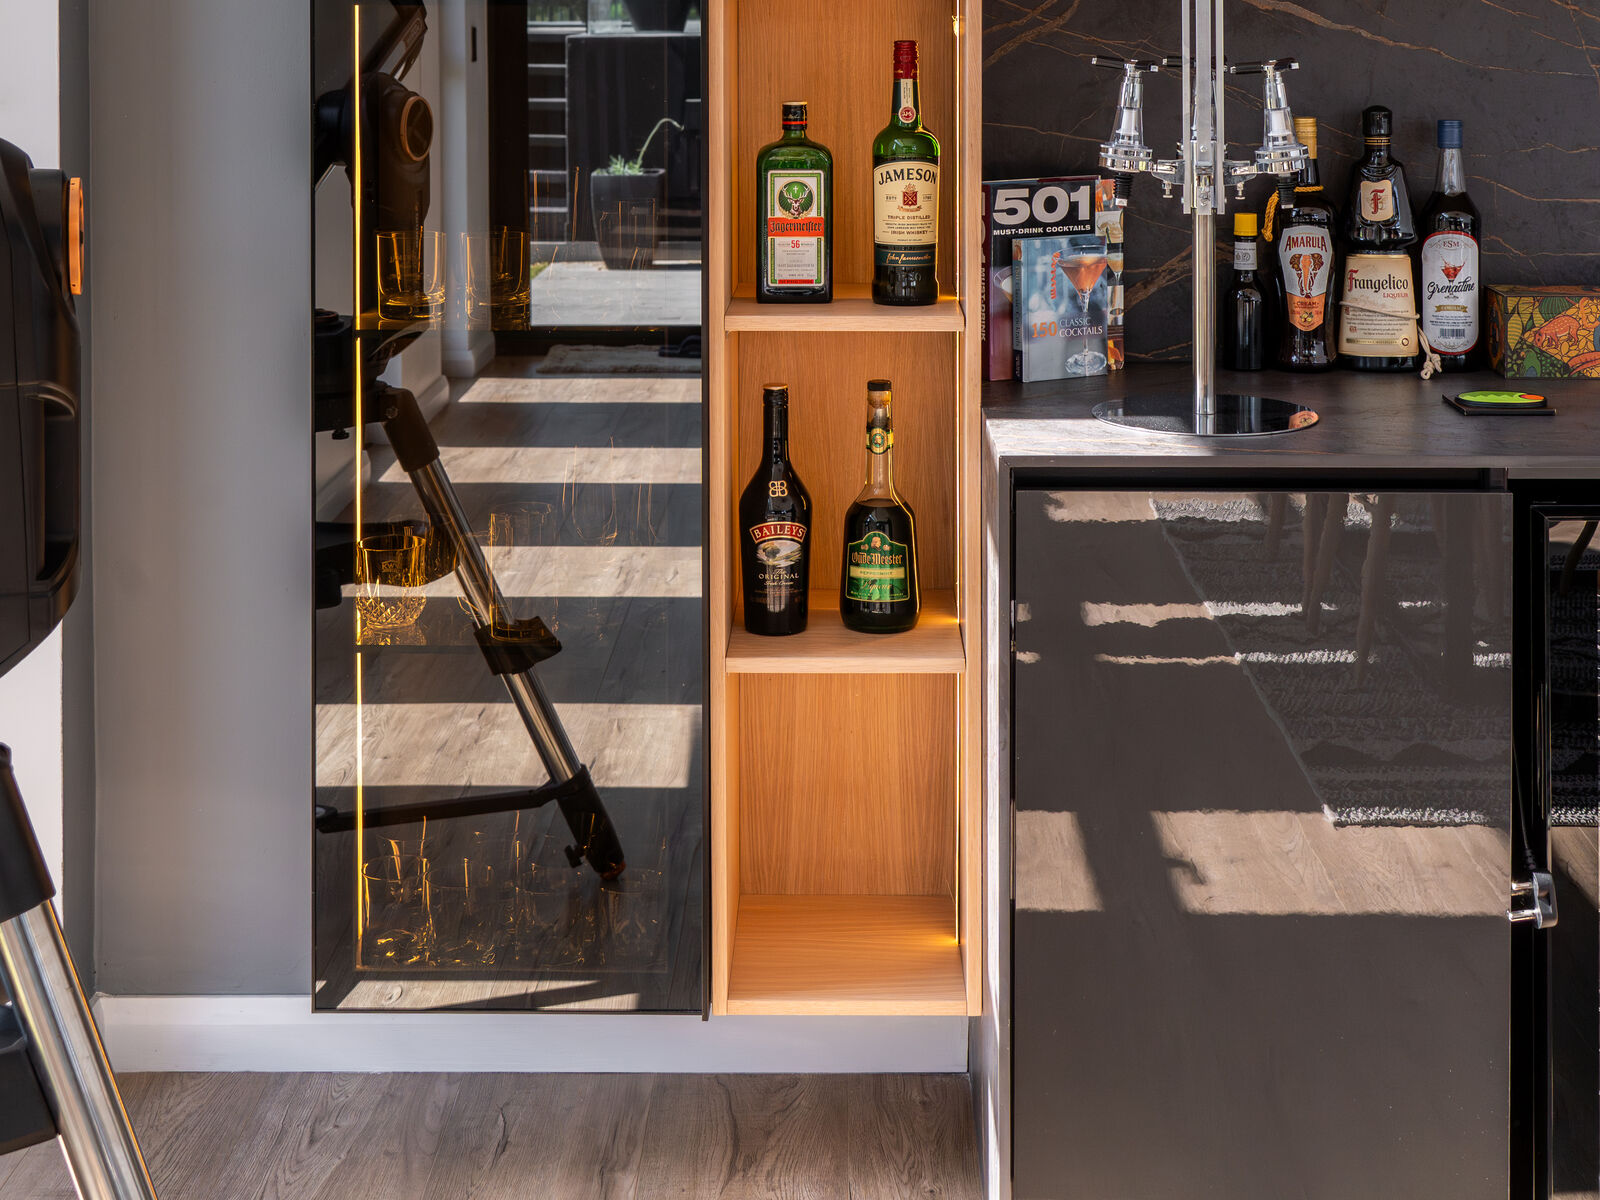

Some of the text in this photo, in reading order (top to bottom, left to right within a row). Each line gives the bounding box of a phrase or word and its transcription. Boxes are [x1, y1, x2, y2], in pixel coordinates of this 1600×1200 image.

[878, 168, 938, 186] JAMESON
[993, 185, 1090, 225] 501
[993, 224, 1092, 236] MUST-DRINK COCKTAILS
[790, 239, 801, 249] 56
[1284, 236, 1328, 253] AMARULA
[1347, 268, 1409, 294] Frangelico
[1427, 276, 1475, 301] Grenadine
[1032, 315, 1092, 338] 150 CLASSIC
[1059, 325, 1103, 338] COCKTAILS
[753, 525, 804, 540] BAILEYS
[870, 552, 903, 566] Meester
[758, 572, 800, 580] ORIGINAL
